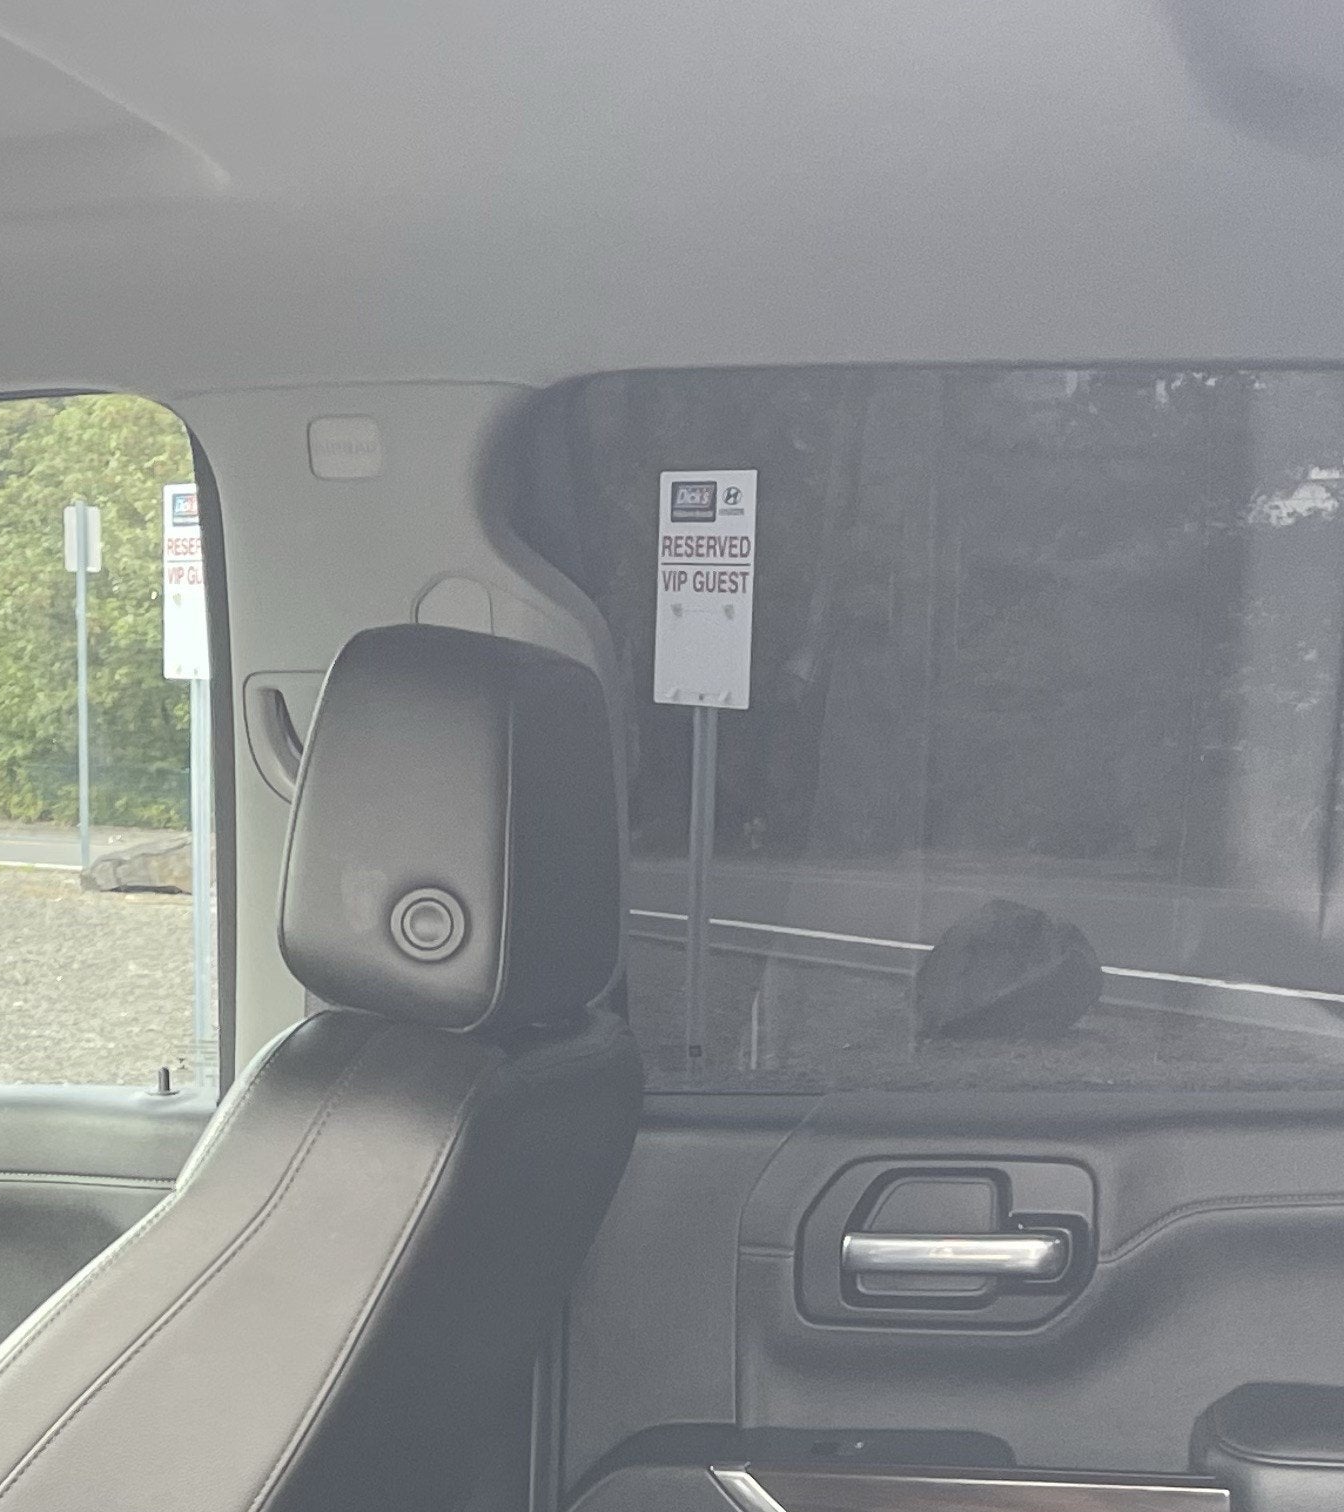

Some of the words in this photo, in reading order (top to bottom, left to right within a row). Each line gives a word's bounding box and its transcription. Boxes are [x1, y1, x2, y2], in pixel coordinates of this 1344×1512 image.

[661, 535, 752, 558] RESERVED
[168, 566, 185, 585] VIP
[662, 571, 688, 593] VIP
[693, 571, 749, 594] GUEST
